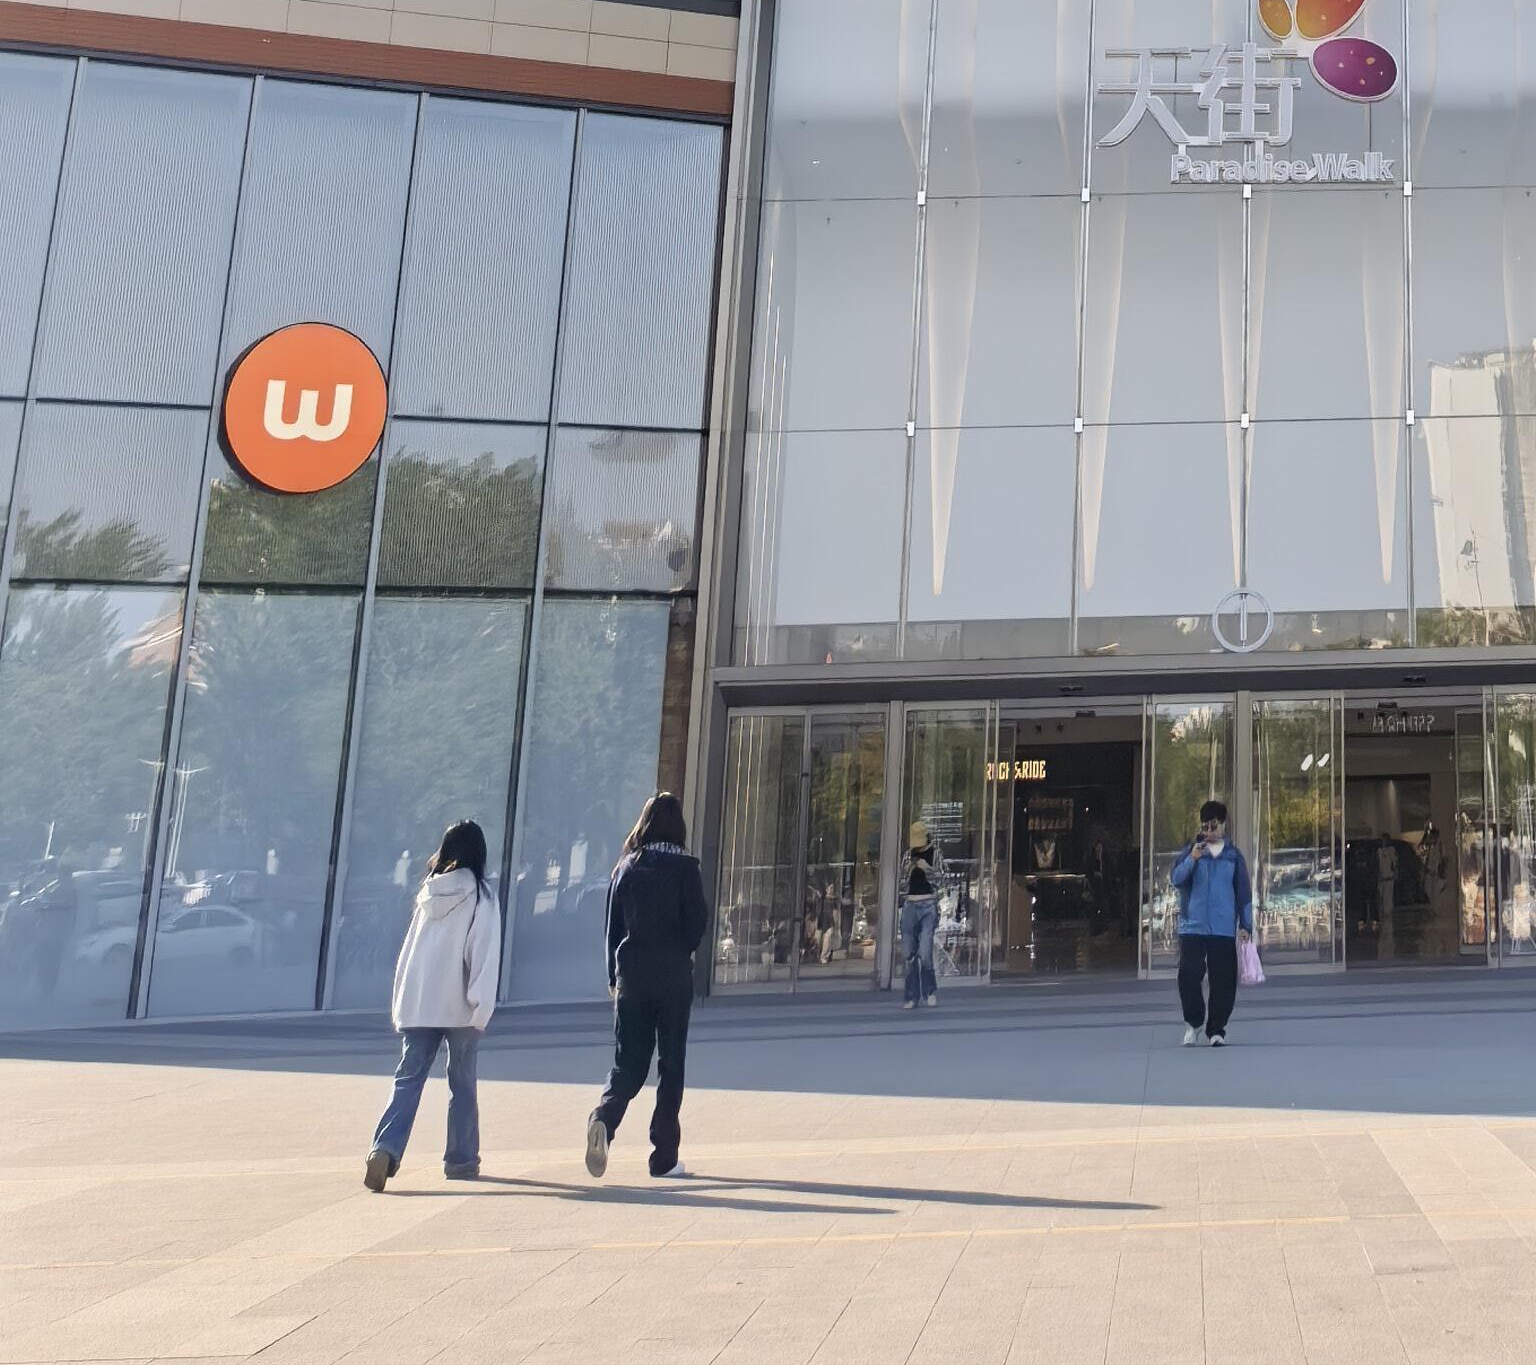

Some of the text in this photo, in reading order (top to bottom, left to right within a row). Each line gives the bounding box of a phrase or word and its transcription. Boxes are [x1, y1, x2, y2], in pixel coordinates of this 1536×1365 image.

[1095, 43, 1302, 149] 天街
[1170, 151, 1396, 184] Paradise Walk
